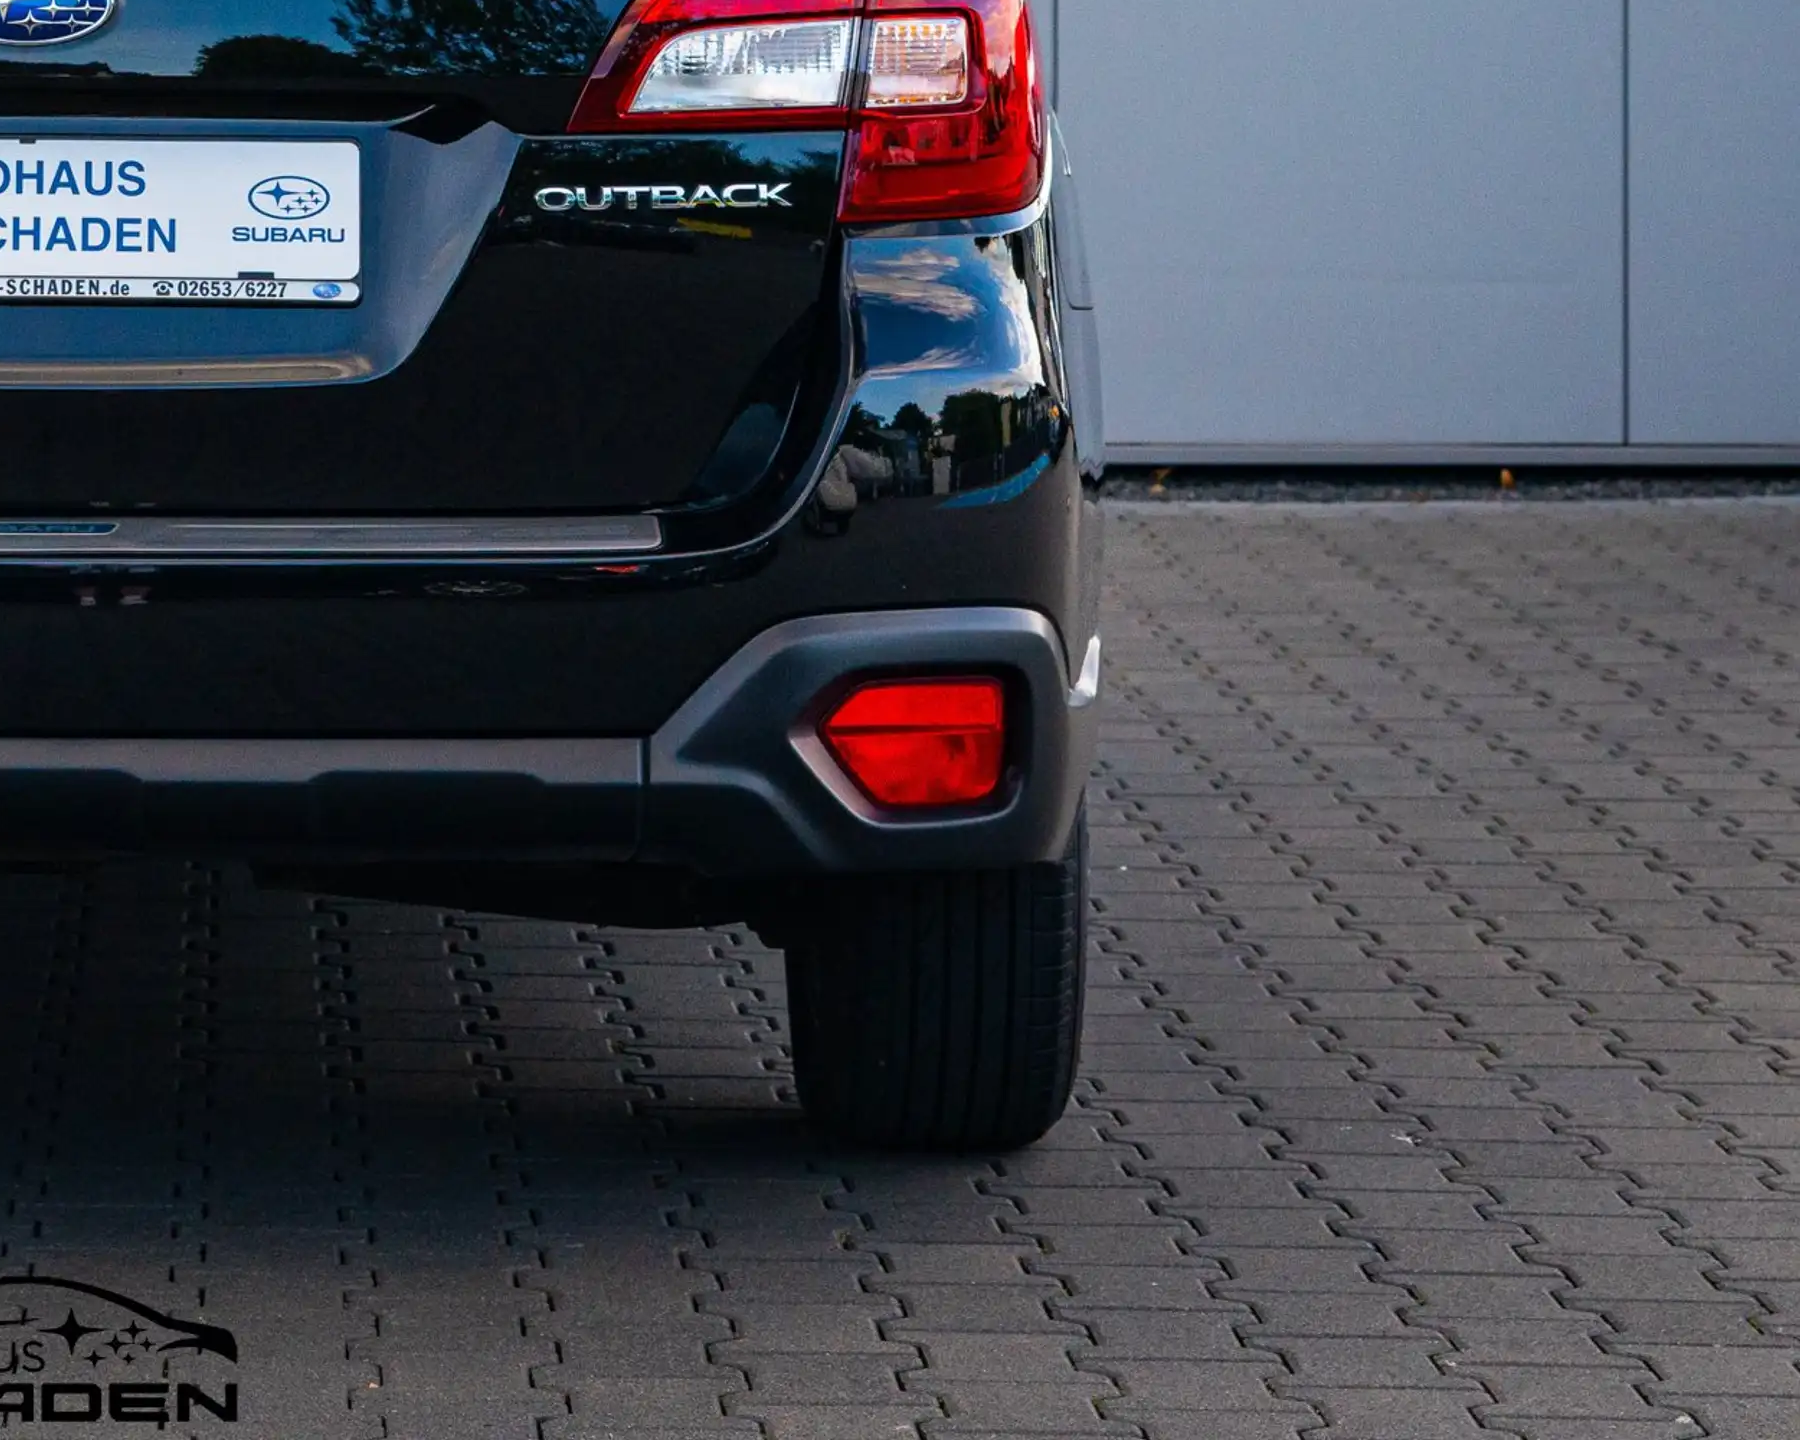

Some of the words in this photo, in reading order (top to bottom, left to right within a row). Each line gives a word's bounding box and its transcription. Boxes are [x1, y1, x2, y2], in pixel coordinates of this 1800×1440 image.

[534, 182, 793, 211] OUTBACK
[231, 226, 346, 243] SUBARU
[177, 280, 288, 299] 02653/6227
